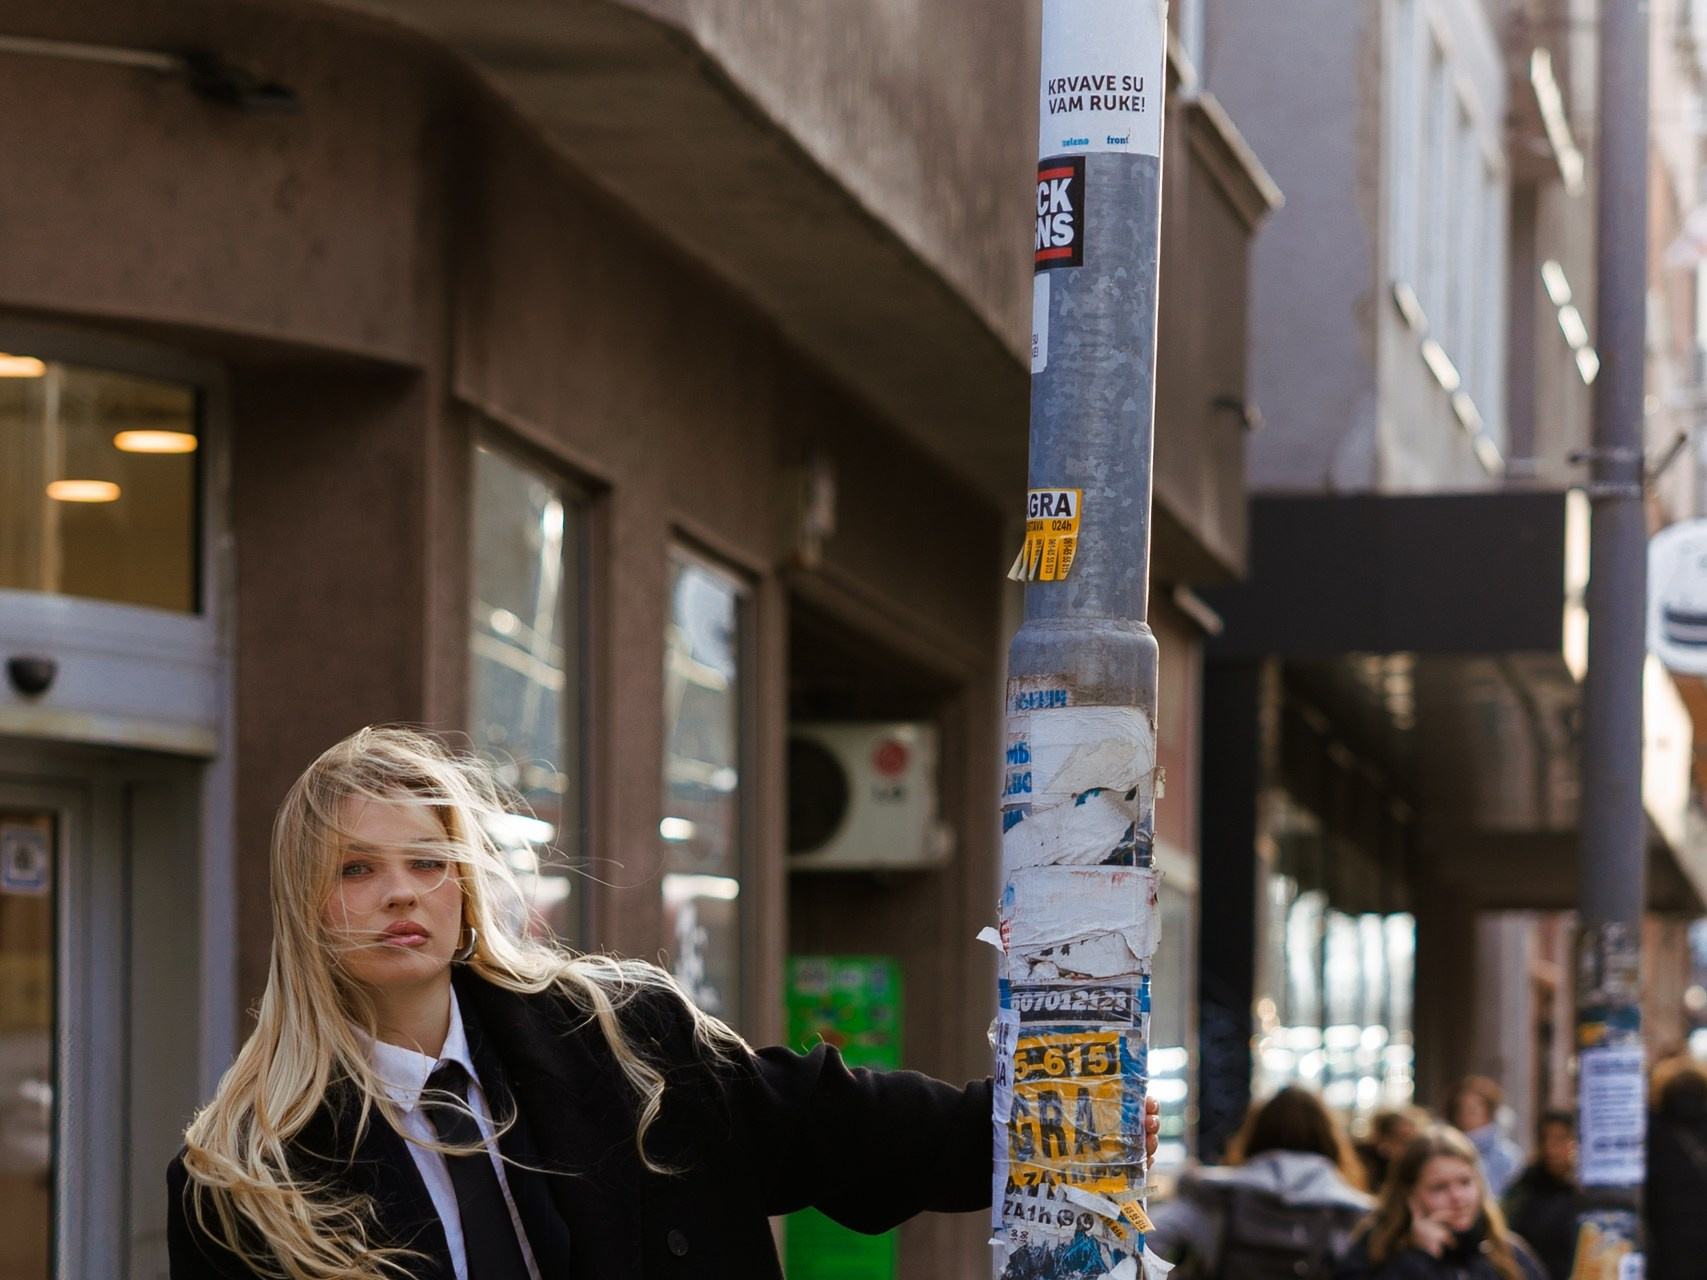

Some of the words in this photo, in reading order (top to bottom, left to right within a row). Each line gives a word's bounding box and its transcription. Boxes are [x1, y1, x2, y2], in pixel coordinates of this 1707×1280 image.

[1048, 75, 1117, 96] KRVAVE
[1122, 75, 1144, 92] SU
[1049, 96, 1083, 115] VAM
[1089, 95, 1146, 113] RUKE!
[1106, 135, 1129, 145] front
[1036, 178, 1073, 216] CK
[1035, 212, 1074, 251] NS
[1028, 493, 1072, 518] GRA
[1052, 520, 1072, 531] 024h
